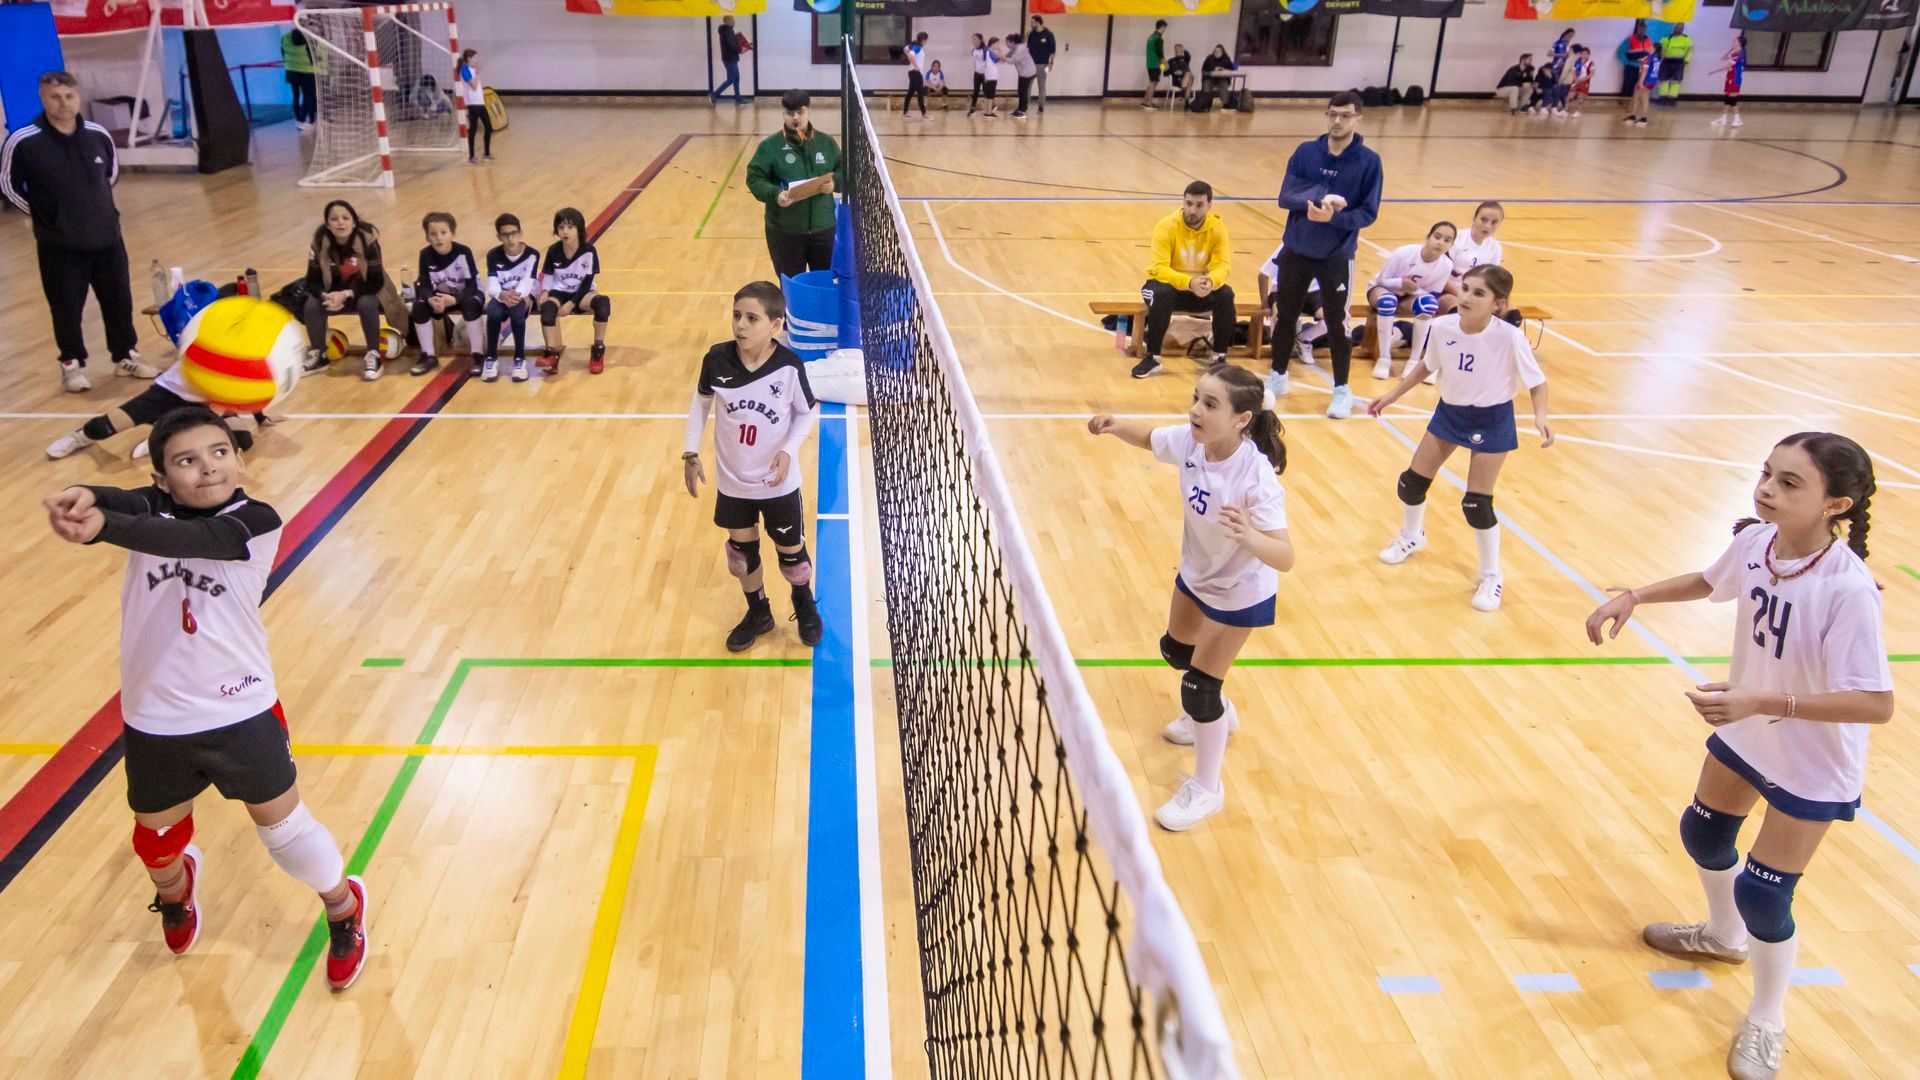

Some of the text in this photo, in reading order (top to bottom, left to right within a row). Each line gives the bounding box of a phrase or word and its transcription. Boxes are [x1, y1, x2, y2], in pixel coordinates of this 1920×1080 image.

[1458, 353, 1475, 373] 12
[739, 423, 757, 447] 10
[1188, 485, 1211, 516] 25
[181, 597, 198, 635] 6
[1751, 586, 1792, 660] 24
